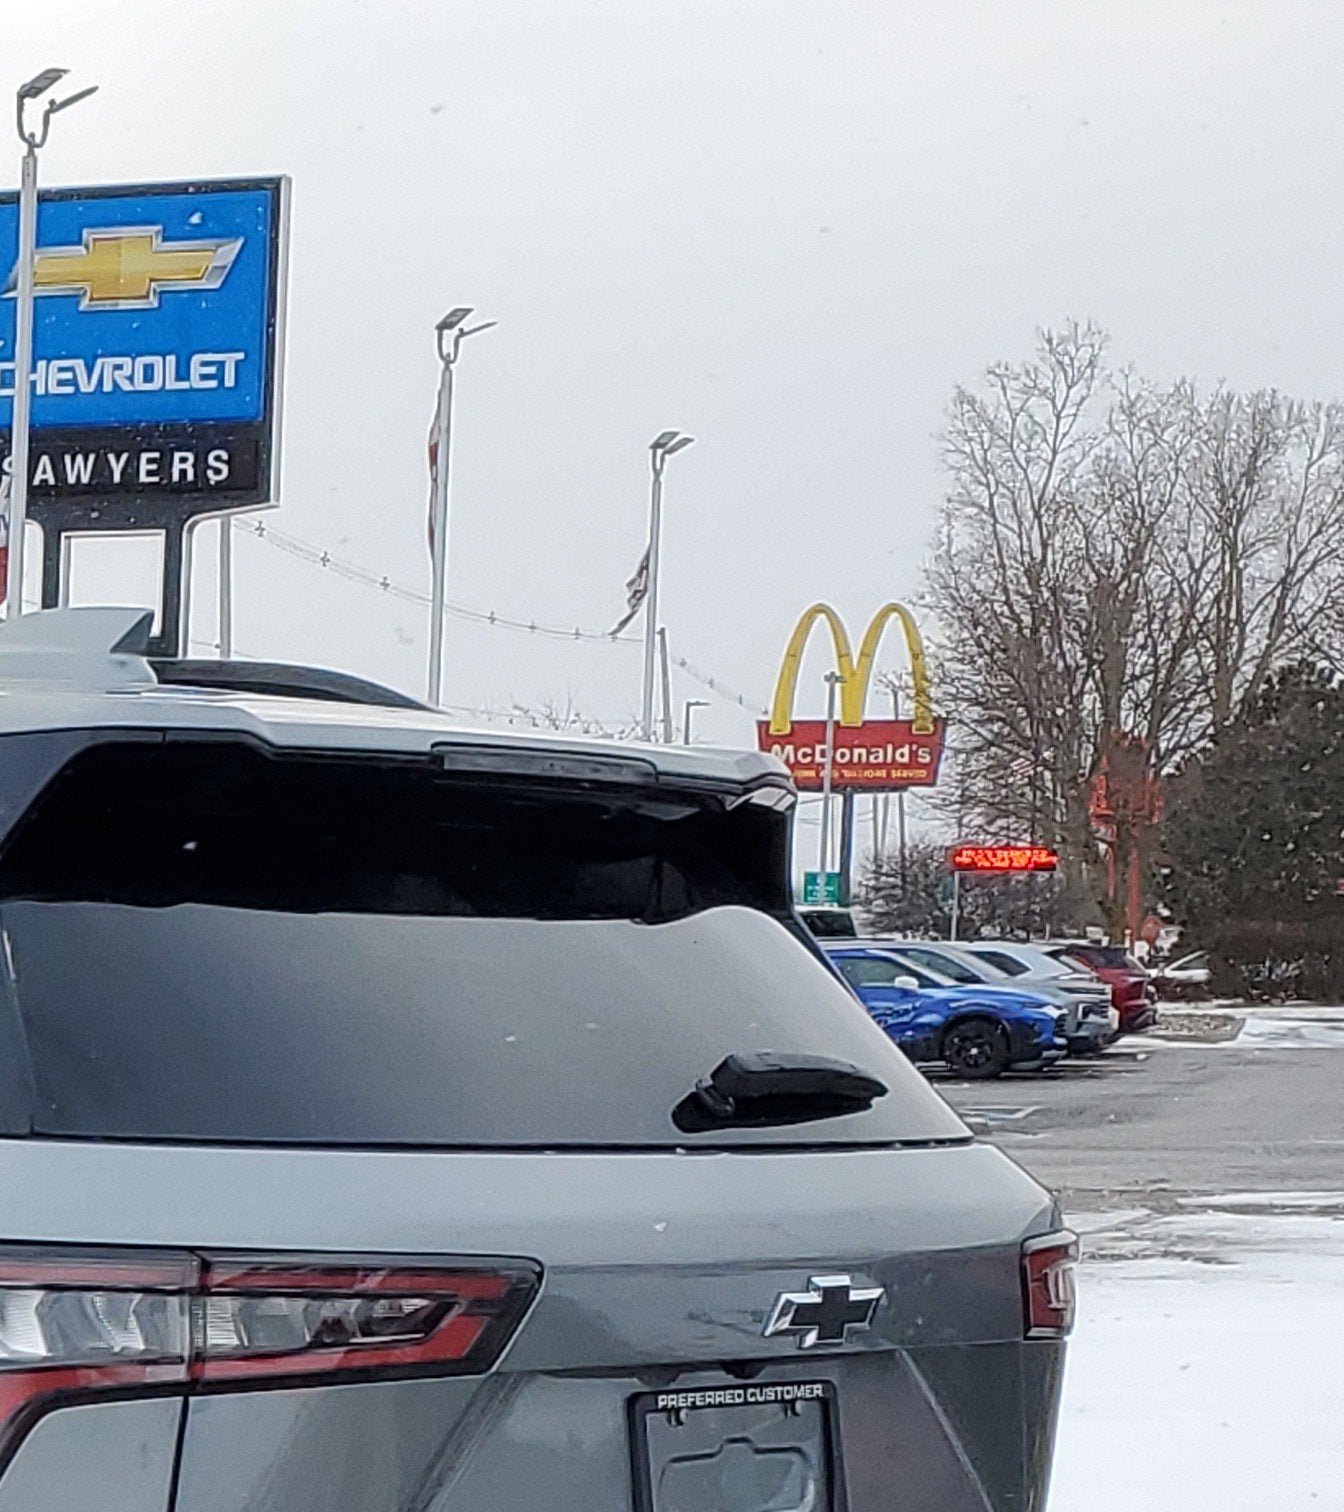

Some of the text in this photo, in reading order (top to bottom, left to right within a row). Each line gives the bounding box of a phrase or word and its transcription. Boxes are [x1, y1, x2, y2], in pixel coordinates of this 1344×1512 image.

[2, 449, 230, 486] AWYERS
[771, 743, 931, 764] McDonald's
[658, 1384, 824, 1409] PREFERRED CUSTOMER
